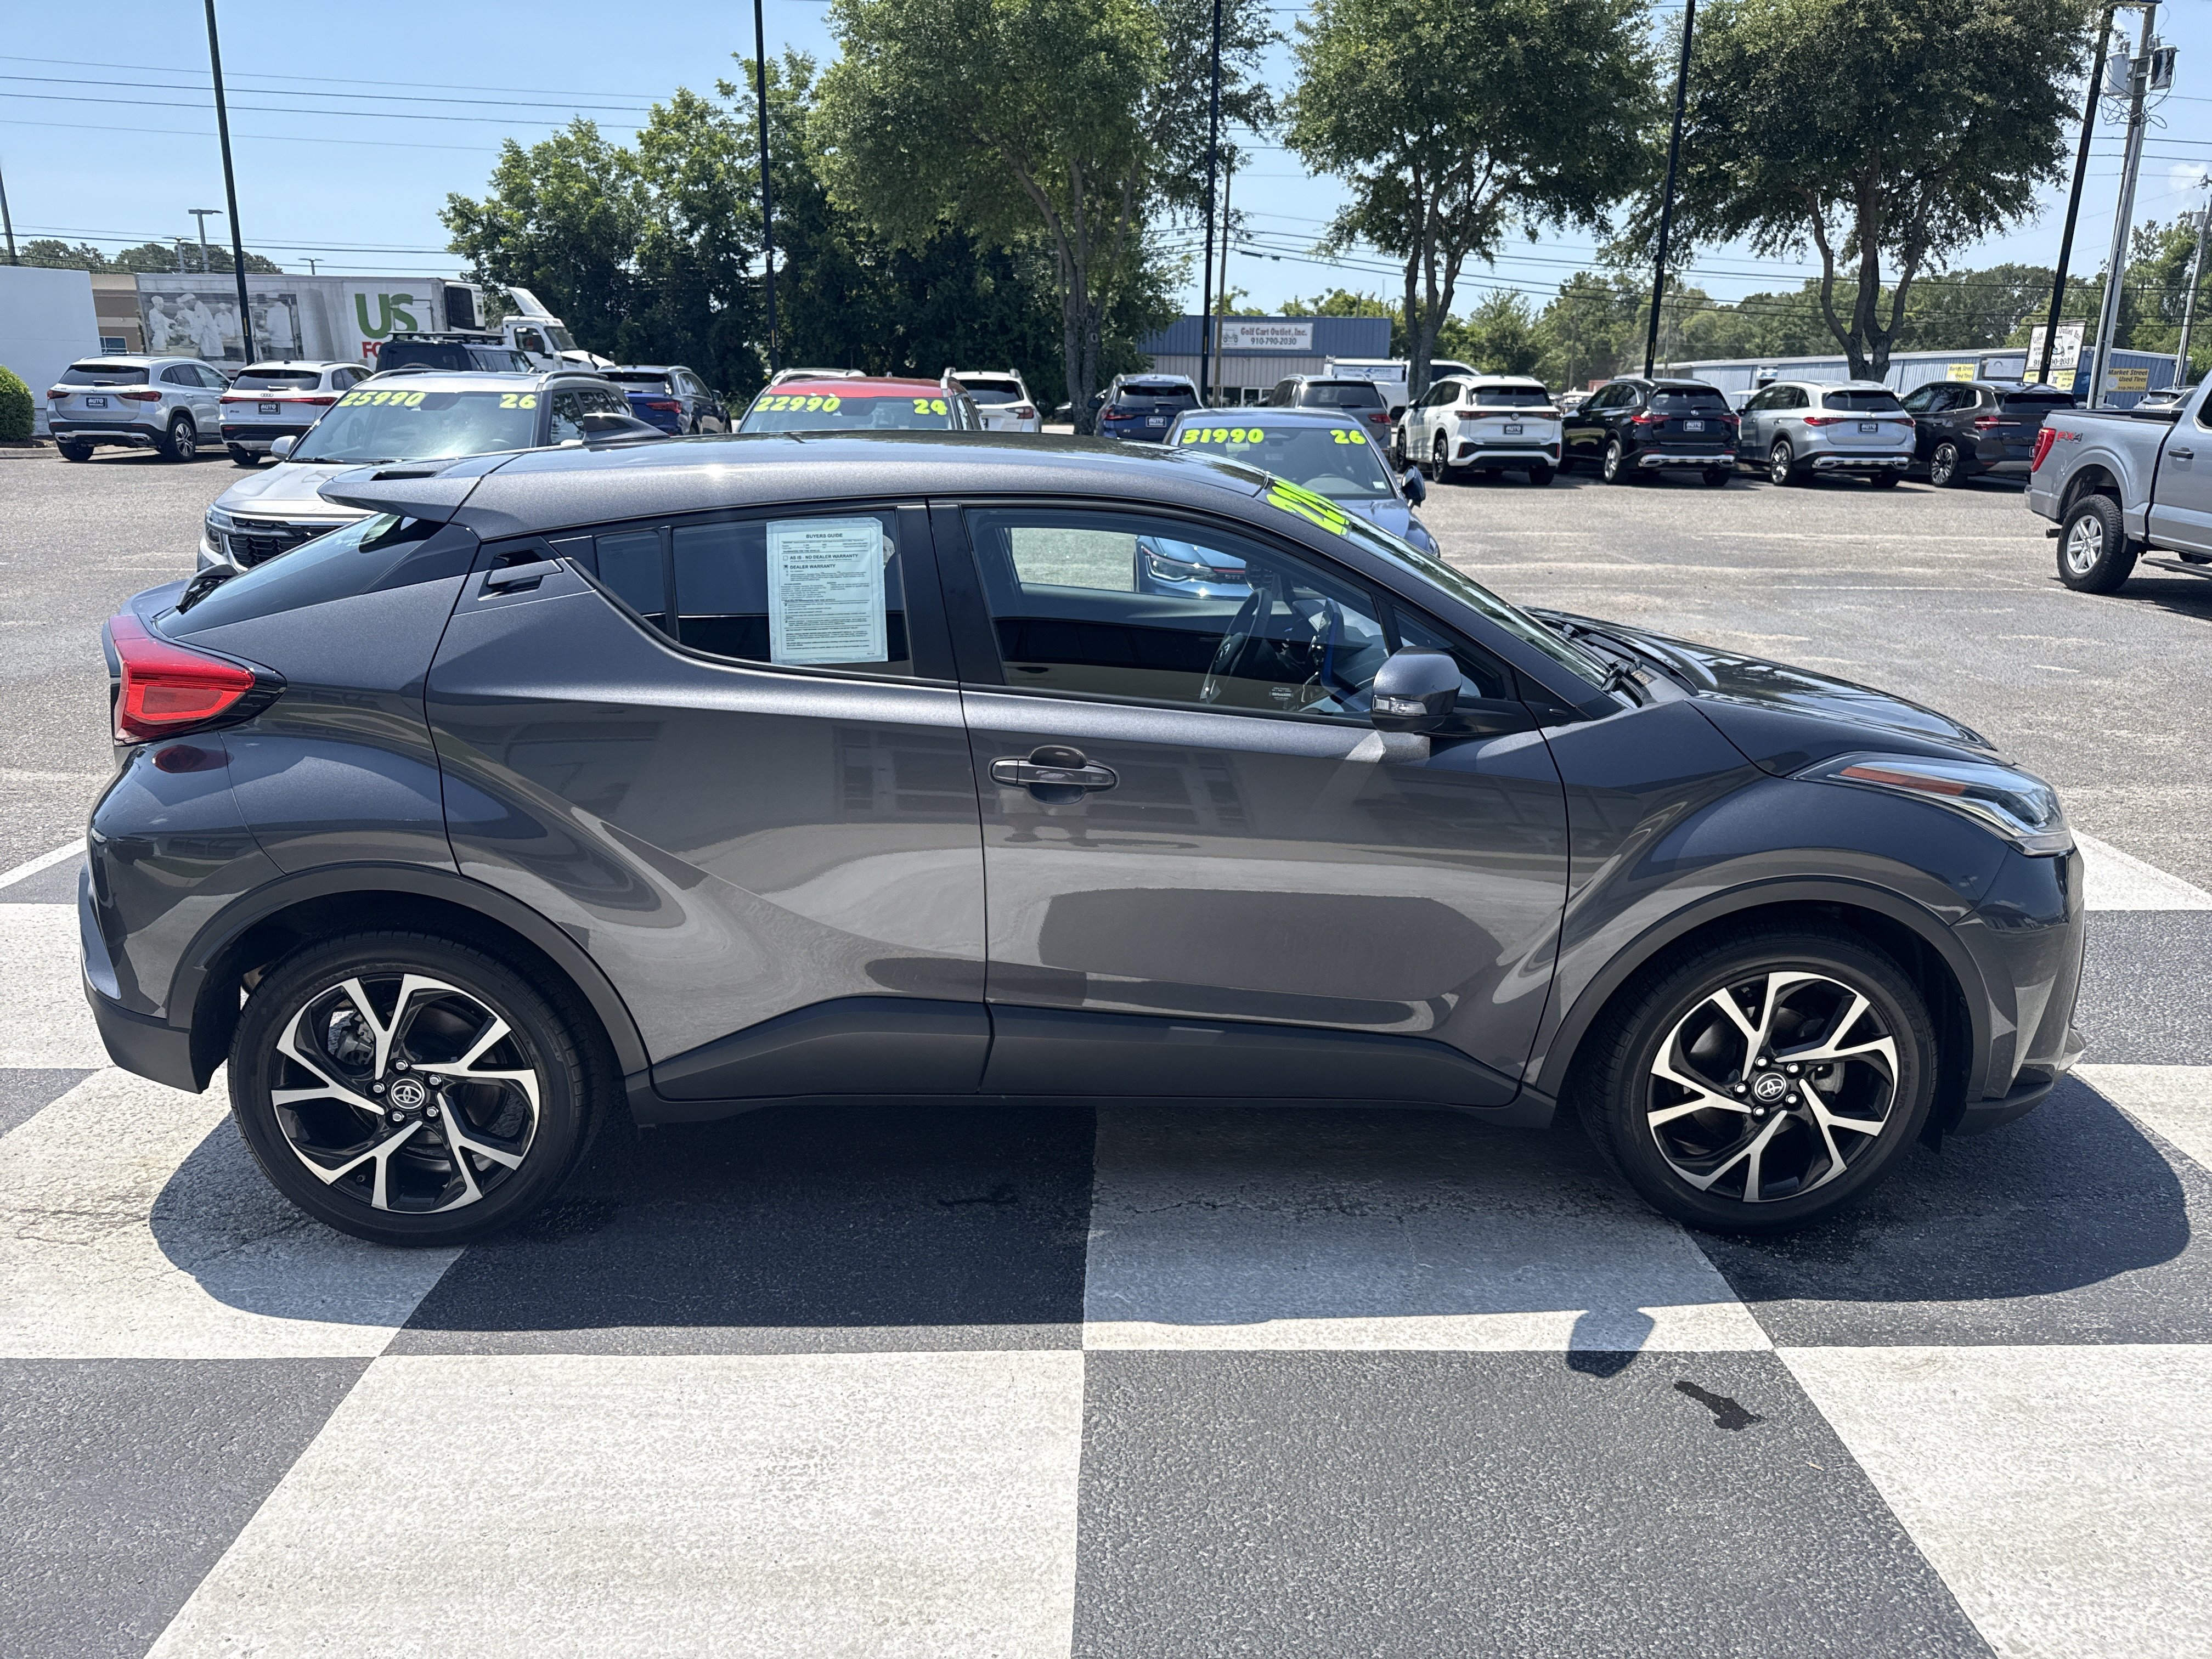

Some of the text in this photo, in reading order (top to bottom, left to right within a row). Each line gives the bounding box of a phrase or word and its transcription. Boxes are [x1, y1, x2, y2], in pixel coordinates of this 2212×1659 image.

[354, 294, 418, 339] US
[1240, 328, 1255, 336] Golf
[1270, 328, 1294, 337] Outlet,
[1294, 328, 1307, 336] Inc.
[337, 391, 537, 409] 25990 26
[753, 396, 948, 415] 22990 24
[1182, 428, 1367, 445] 31990 26
[2056, 431, 2083, 442] FX4
